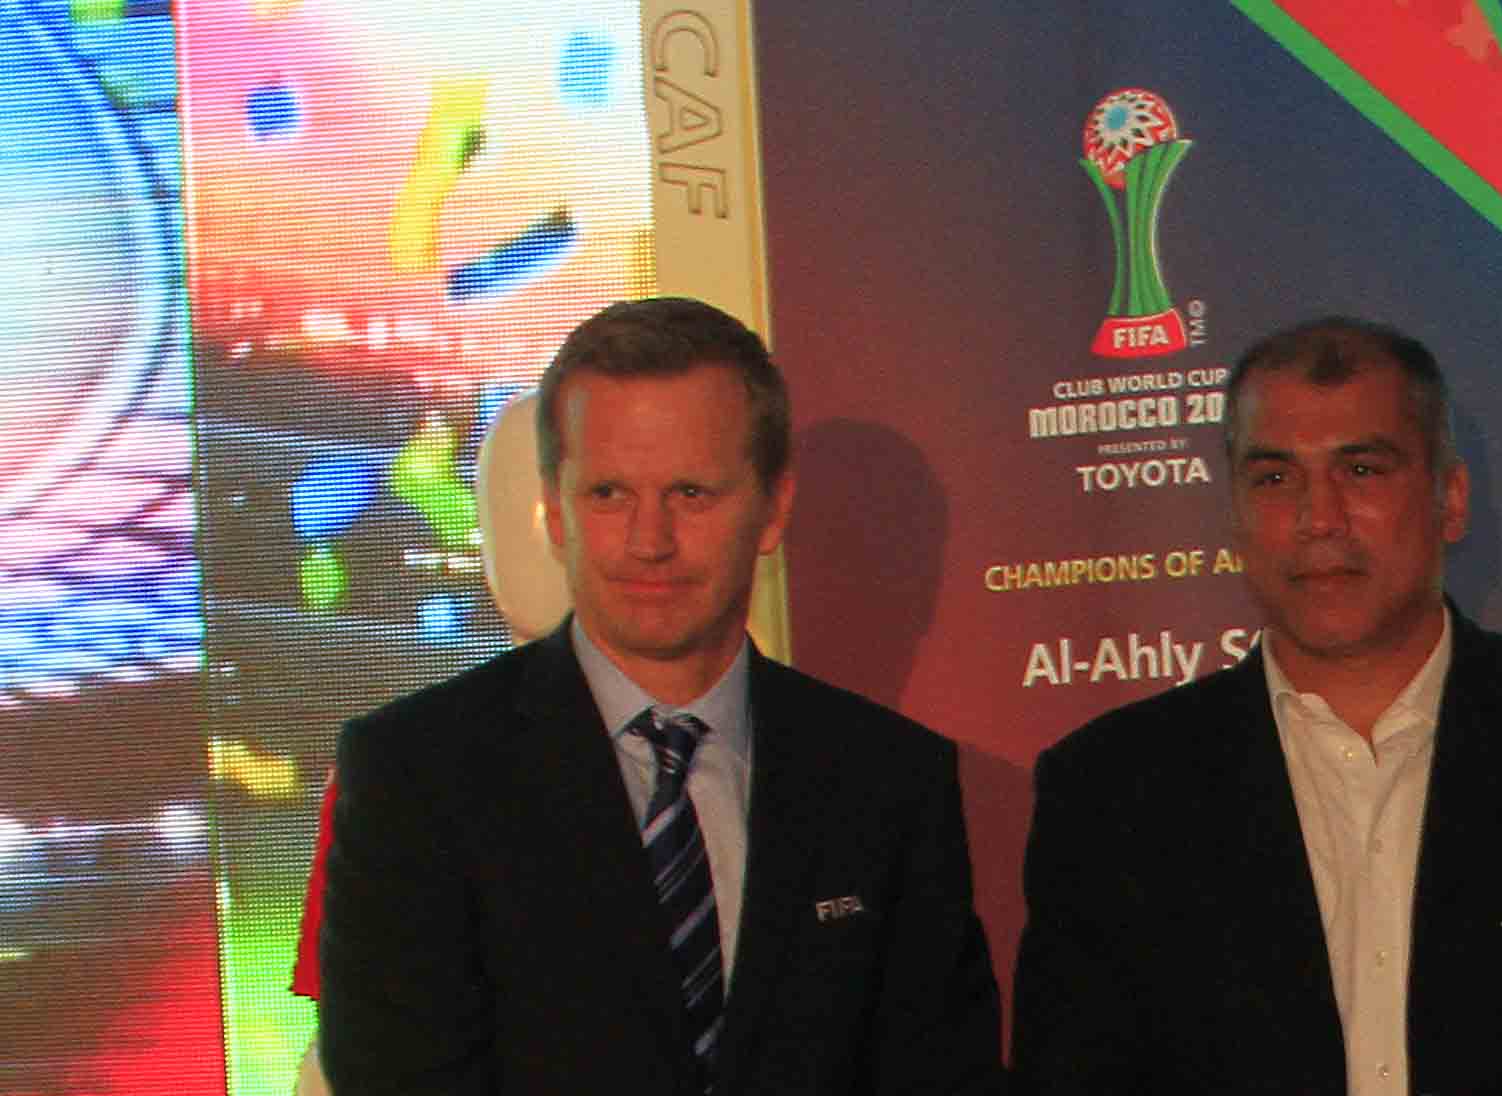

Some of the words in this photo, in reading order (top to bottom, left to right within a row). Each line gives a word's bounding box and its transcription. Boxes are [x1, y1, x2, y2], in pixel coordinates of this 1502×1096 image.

[652, 9, 729, 219] CAF
[1113, 325, 1169, 349] FIFA
[1053, 380, 1105, 399] CLUB
[1107, 372, 1183, 394] WORLD
[1187, 368, 1229, 387] CUP
[1029, 396, 1178, 438] MOROCCO
[1076, 458, 1209, 492] TOYOTA
[985, 553, 1155, 591] CHAMPIONS
[1165, 550, 1203, 577] OF
[1022, 631, 1204, 687] Al-Ahly
